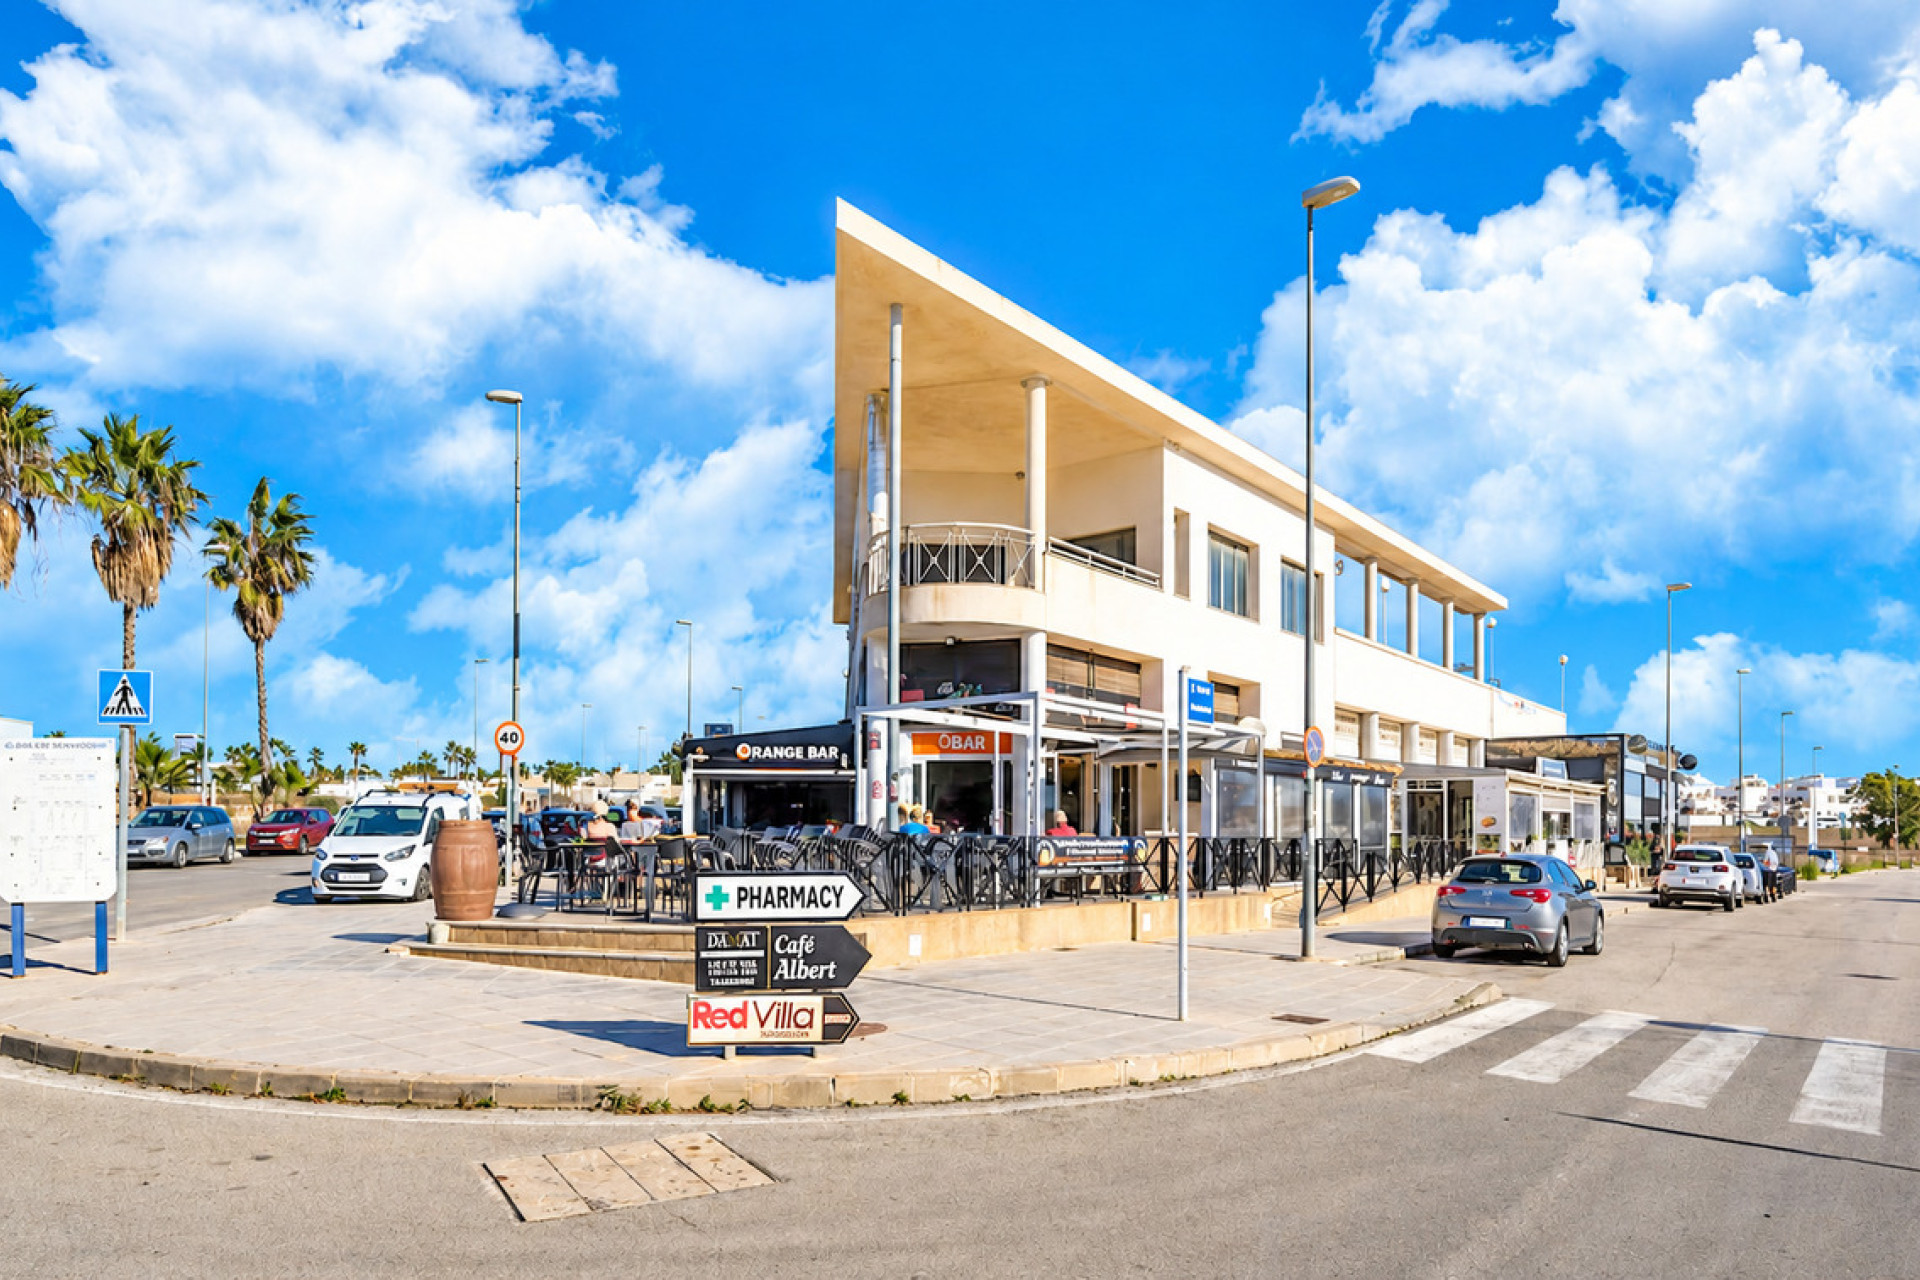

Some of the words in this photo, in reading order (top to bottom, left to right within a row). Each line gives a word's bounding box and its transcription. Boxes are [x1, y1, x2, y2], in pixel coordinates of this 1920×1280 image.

[500, 732, 519, 744] 40
[736, 743, 803, 760] ORANGE
[808, 746, 839, 759] BAR
[737, 885, 844, 909] PHARMACY
[775, 934, 815, 957] Café
[774, 958, 838, 981] Albert
[693, 1001, 749, 1029] Red
[753, 1002, 814, 1028] Villa
